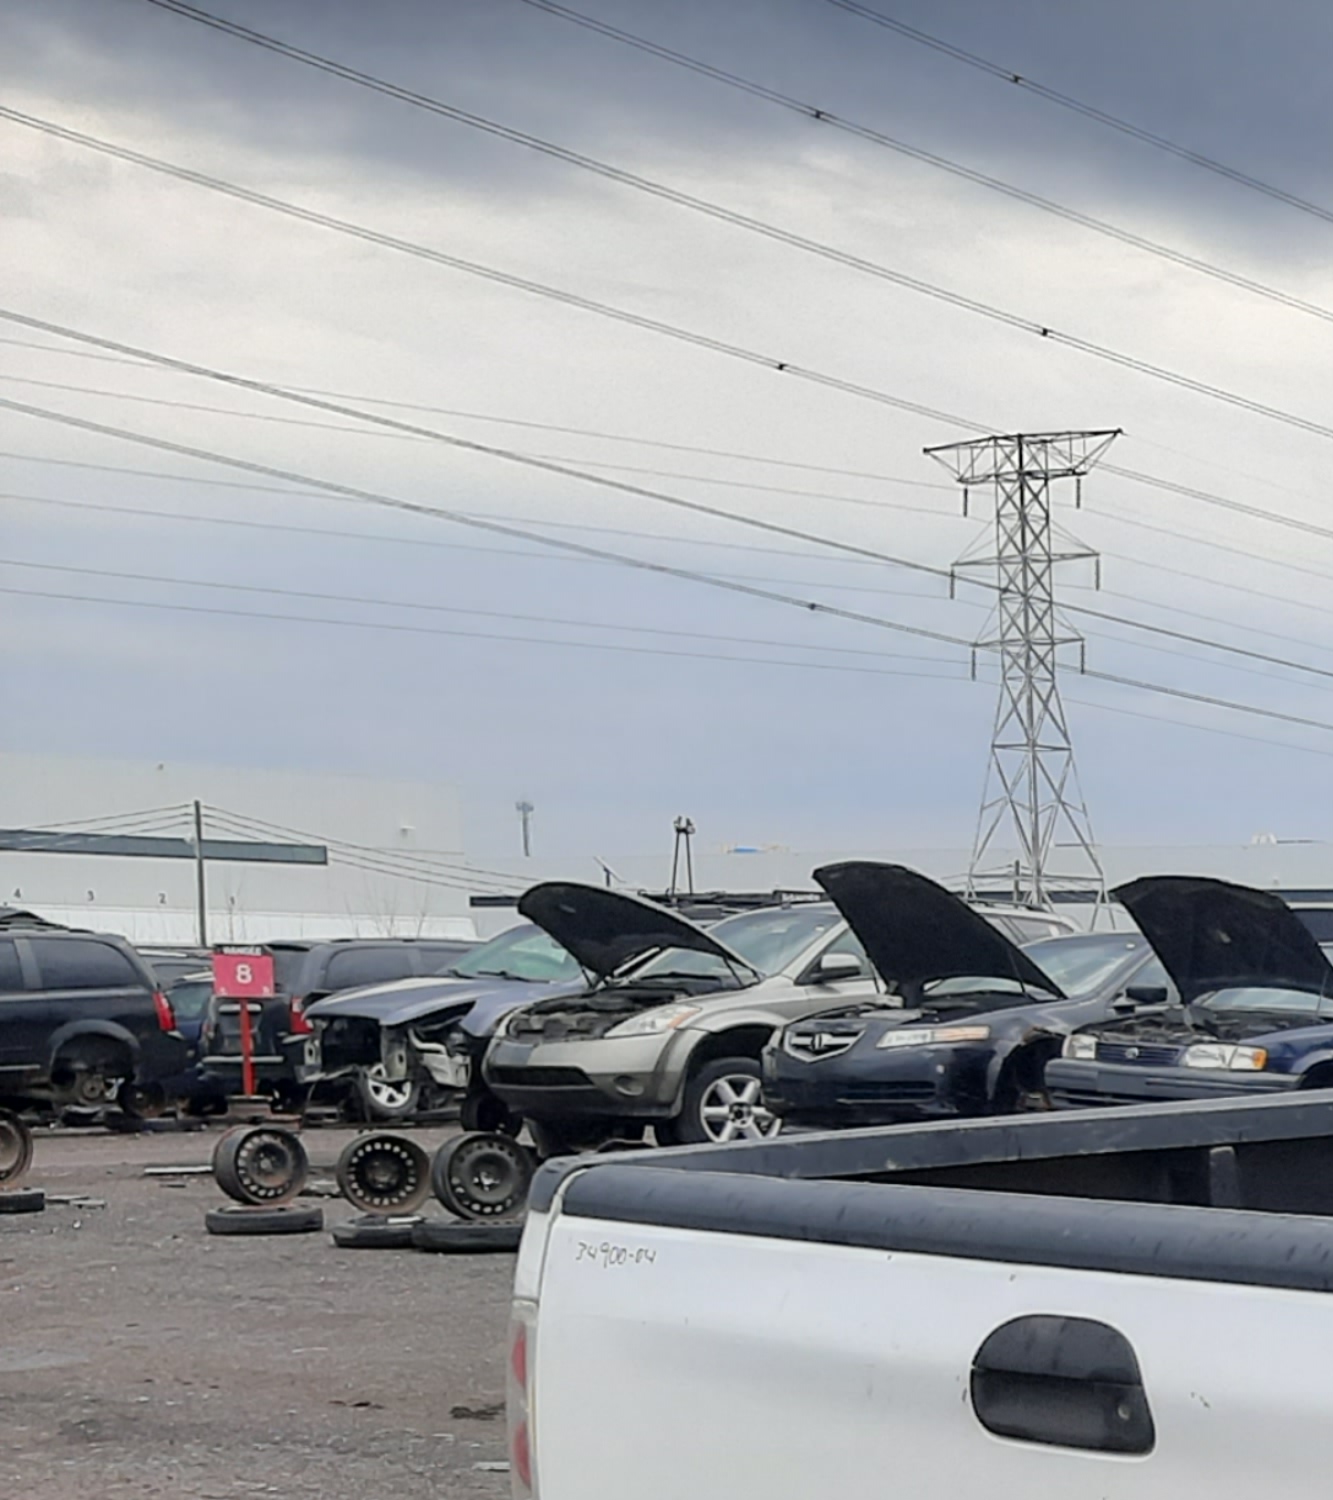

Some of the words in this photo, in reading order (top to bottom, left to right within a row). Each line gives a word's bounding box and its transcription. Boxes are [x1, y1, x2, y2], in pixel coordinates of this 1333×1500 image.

[87, 890, 95, 901] 3
[159, 893, 167, 904] 2
[236, 963, 253, 985] 8
